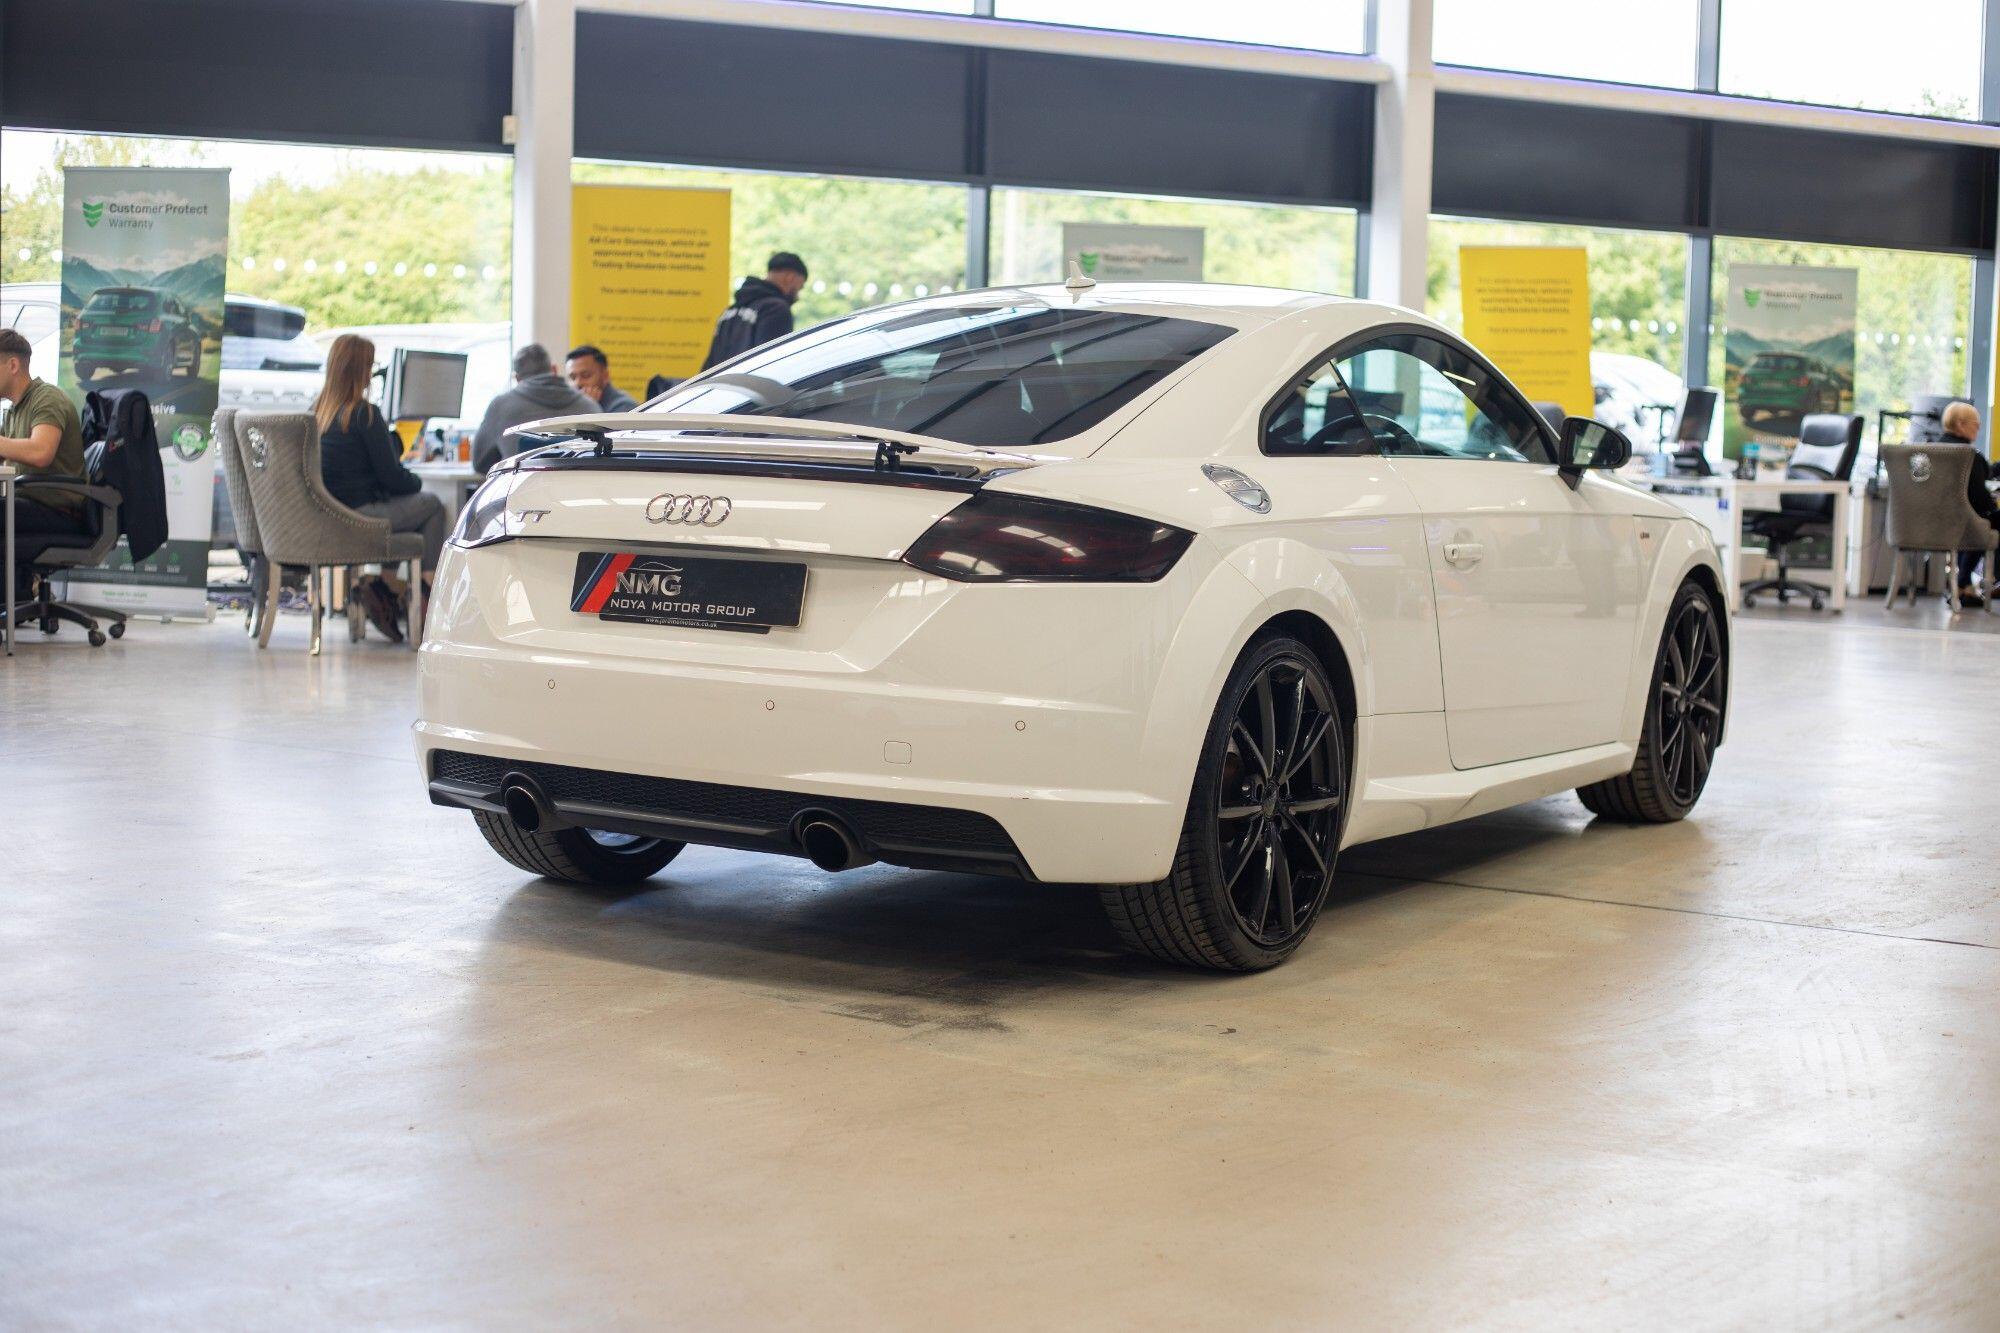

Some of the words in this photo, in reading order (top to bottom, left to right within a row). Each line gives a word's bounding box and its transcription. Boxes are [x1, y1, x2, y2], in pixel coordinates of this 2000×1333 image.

[109, 203, 162, 214] Customer
[165, 204, 208, 216] Protect
[109, 219, 153, 230] Warranty
[516, 509, 551, 523] TT
[613, 571, 682, 597] NMG
[610, 598, 646, 610] NOYA
[652, 601, 700, 613] MOTOR
[706, 604, 756, 617] GROUP
